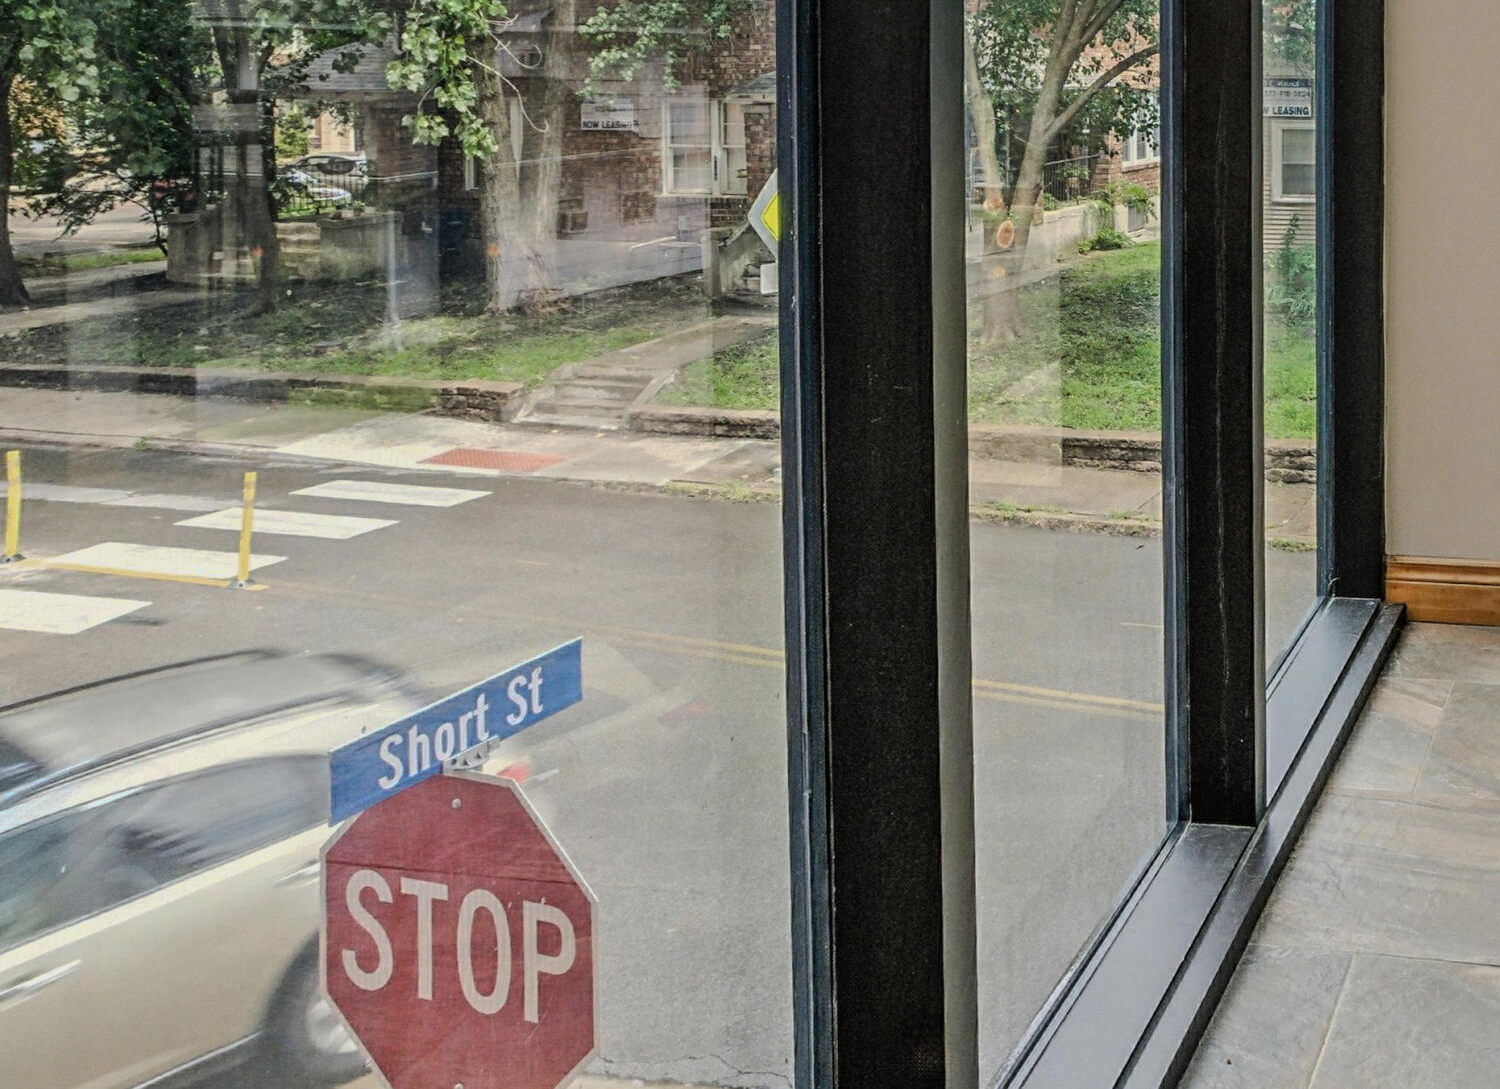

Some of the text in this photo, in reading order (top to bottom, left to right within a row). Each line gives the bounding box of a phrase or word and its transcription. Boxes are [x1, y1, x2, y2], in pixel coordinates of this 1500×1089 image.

[1272, 106, 1310, 116] LEASING
[377, 667, 544, 790] Short St
[341, 869, 577, 1025] STOP
